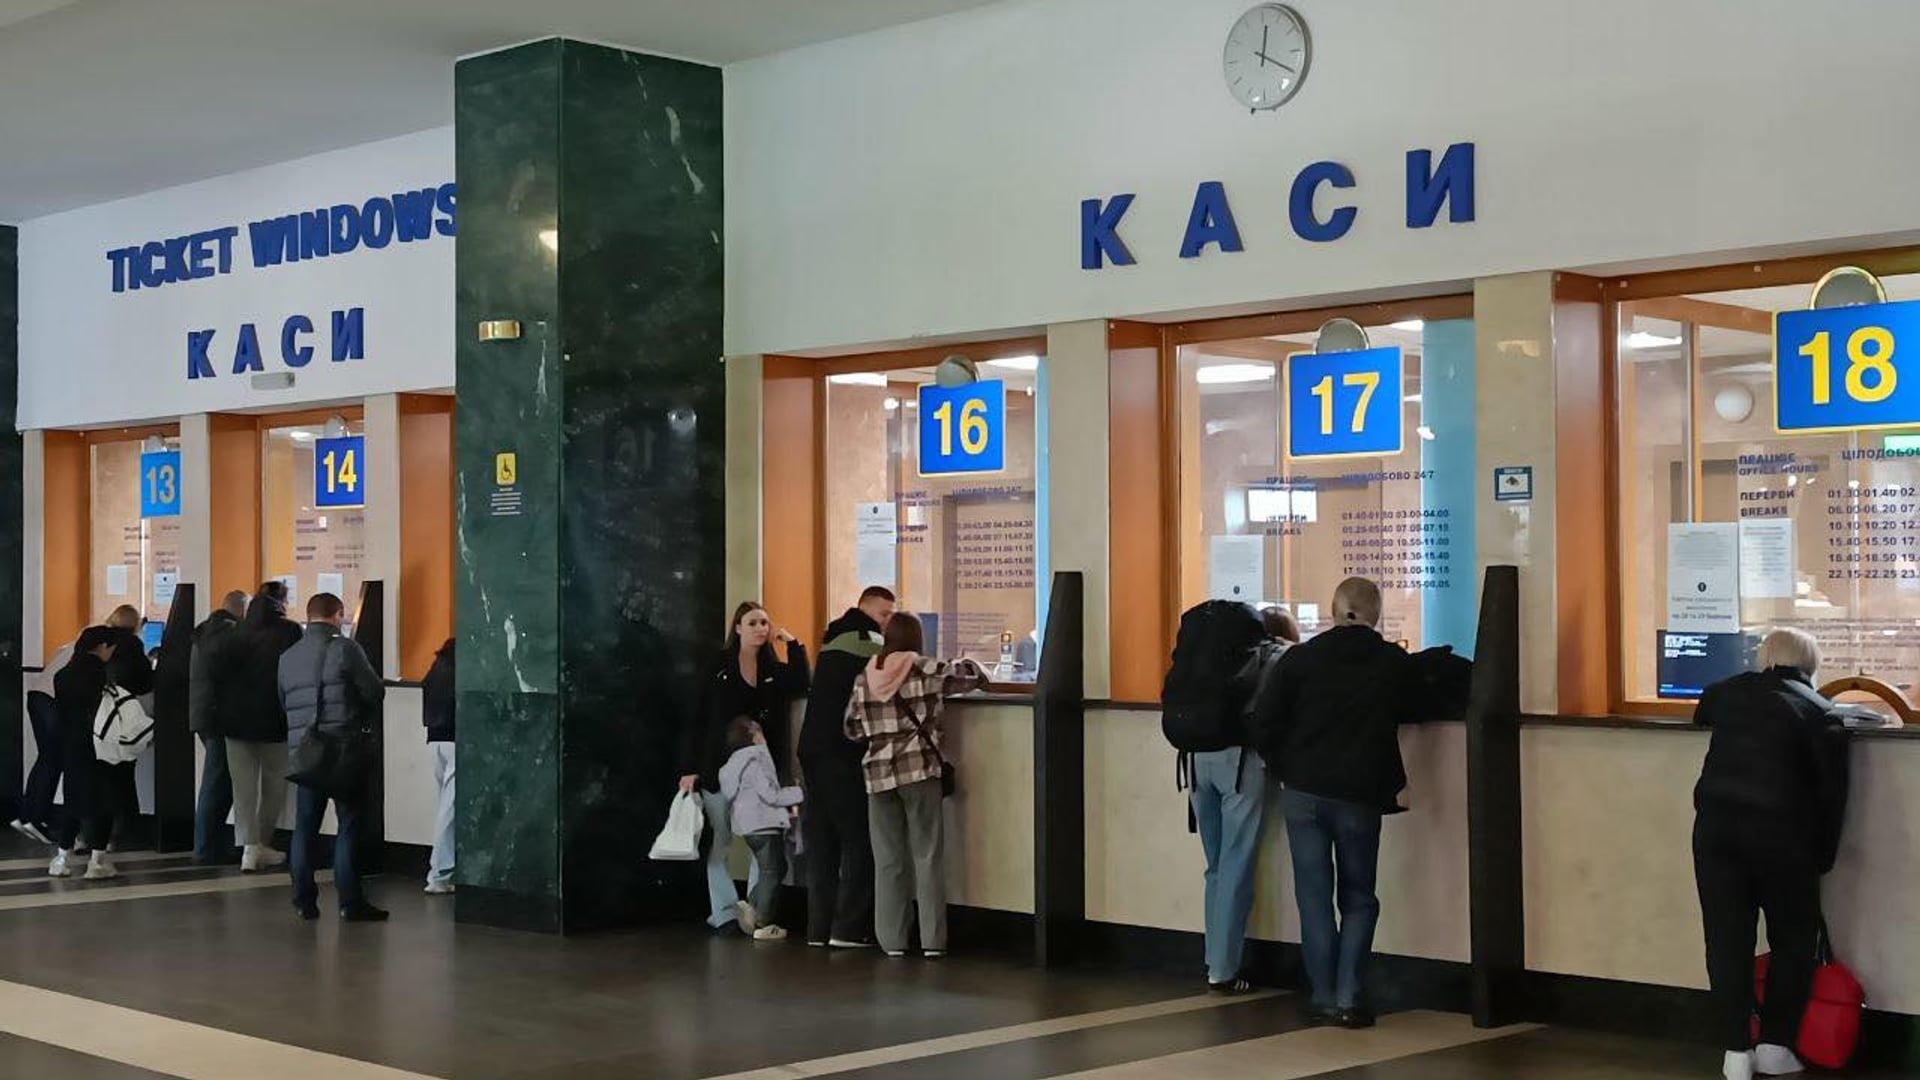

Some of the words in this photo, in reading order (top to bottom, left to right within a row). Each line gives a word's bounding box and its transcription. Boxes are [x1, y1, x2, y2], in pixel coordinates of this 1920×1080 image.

[107, 226, 239, 292] TICKET
[249, 183, 457, 268] WINDOWS
[1081, 142, 1476, 270] КАСИ
[187, 307, 364, 380] КАСИ
[1798, 325, 1898, 405] 18
[933, 399, 989, 456] 16
[1311, 372, 1380, 435] 17
[146, 464, 176, 505] 13
[322, 449, 358, 494] 14
[1740, 505, 1788, 518] BREAKS
